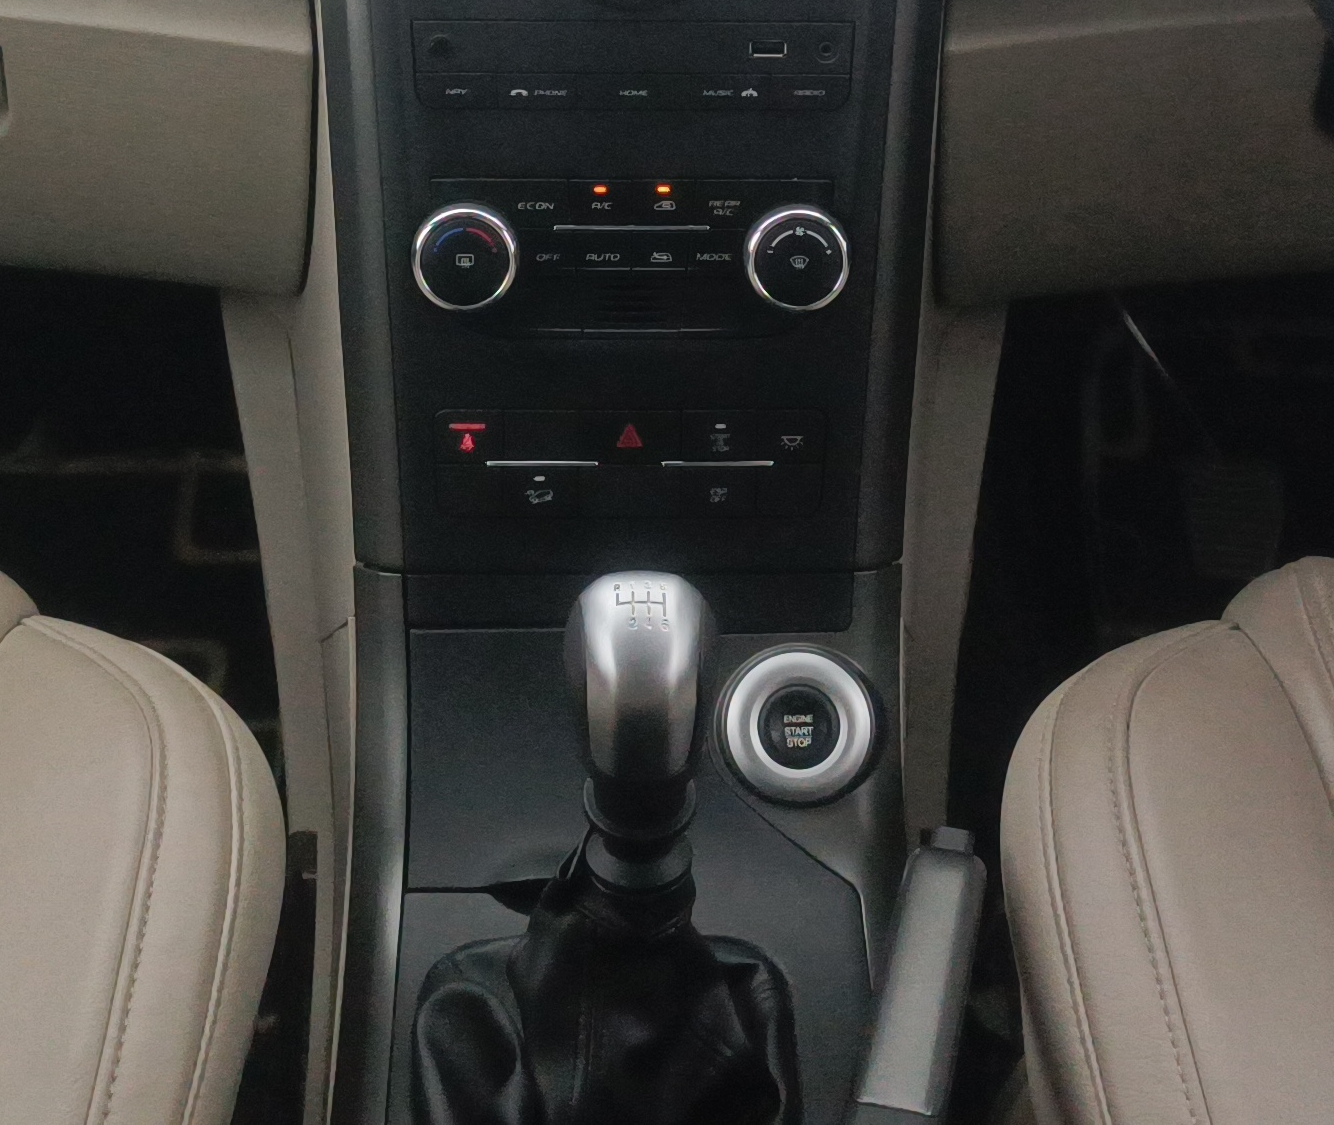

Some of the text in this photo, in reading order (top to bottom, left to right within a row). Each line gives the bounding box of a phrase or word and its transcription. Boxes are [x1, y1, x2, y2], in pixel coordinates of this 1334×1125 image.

[534, 89, 567, 97] PHONE
[619, 89, 648, 97] HOME
[702, 89, 734, 97] MUSIC
[517, 201, 554, 210] ECON
[591, 201, 613, 210] A/C
[708, 200, 741, 208] REAR
[713, 208, 734, 216] A/C
[535, 253, 561, 261] OFF
[585, 253, 620, 261] AUTO
[696, 253, 733, 261] MODE
[783, 714, 814, 724] ENGINE
[784, 726, 814, 737] START
[786, 737, 812, 748] STOP
